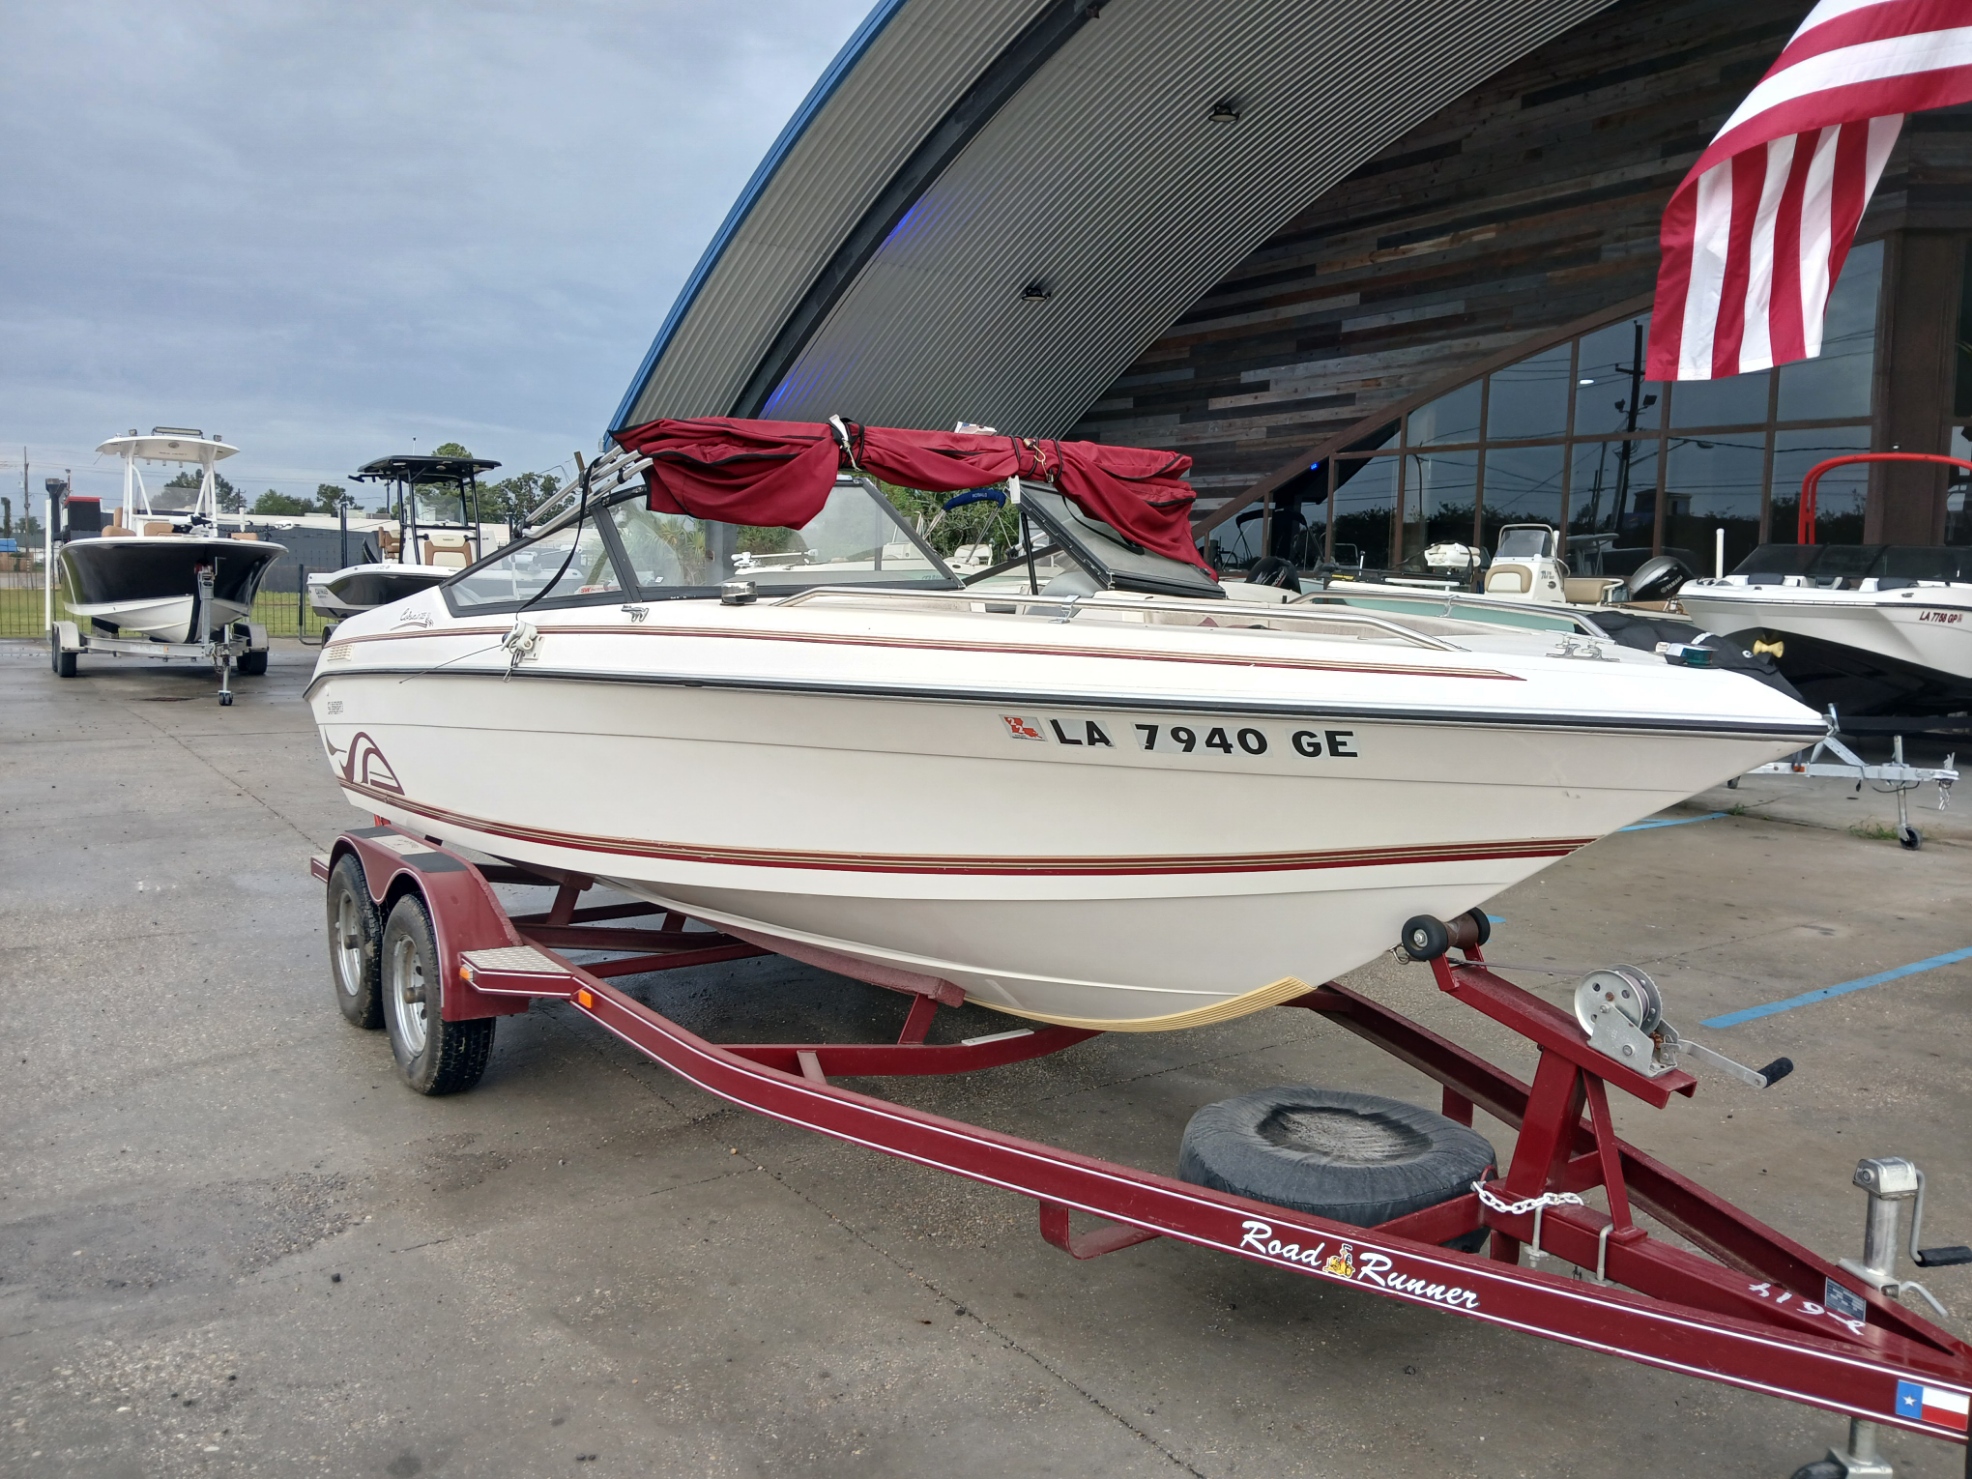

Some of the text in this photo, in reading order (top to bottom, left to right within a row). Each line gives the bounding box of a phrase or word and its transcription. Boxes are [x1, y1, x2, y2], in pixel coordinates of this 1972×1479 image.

[1919, 611, 1930, 621] LA
[1049, 718, 1359, 758] LA 7940 GE
[1240, 1220, 1480, 1309] Road Runner
